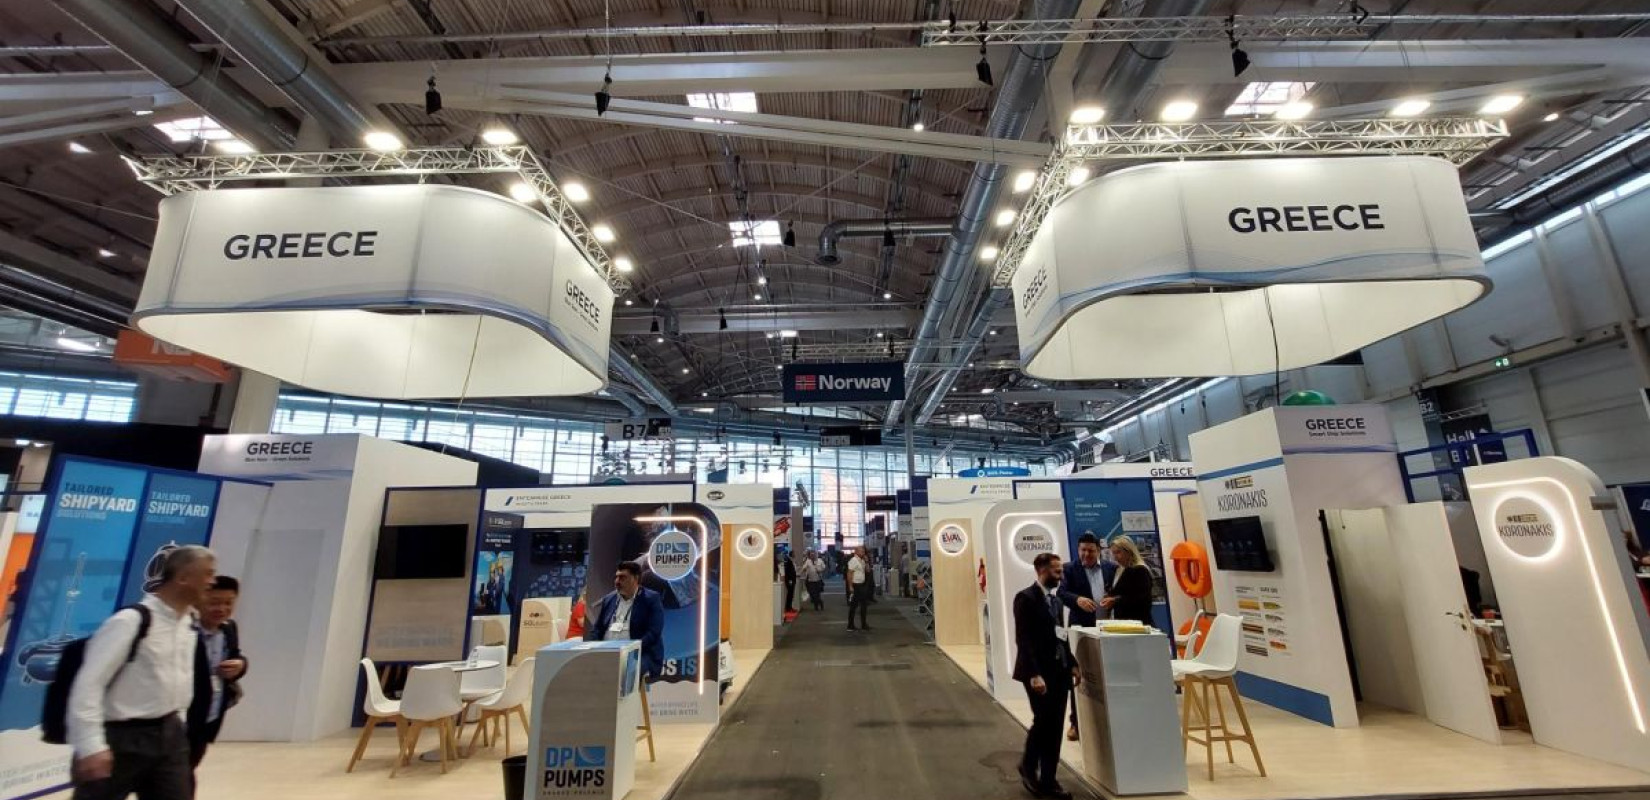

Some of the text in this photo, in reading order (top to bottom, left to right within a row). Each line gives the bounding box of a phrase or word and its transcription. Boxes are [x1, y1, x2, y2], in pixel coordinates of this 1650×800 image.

[1228, 204, 1385, 233] GREECE
[223, 231, 378, 260] GREECE
[1022, 265, 1047, 309] GREECE
[566, 280, 600, 323] GREECE
[819, 374, 891, 392] Norway
[622, 424, 647, 439] B7
[1305, 417, 1366, 430] GREECE
[247, 441, 313, 455] GREECE
[1150, 467, 1194, 477] GREECE
[65, 482, 114, 496] TAILORED
[151, 491, 191, 503] TAILORED
[59, 493, 137, 513] SHIPYARD
[1217, 489, 1268, 511] KORONAKIS
[148, 501, 210, 518] SHIPYARD
[1498, 523, 1554, 537] KORONAKIS
[655, 542, 672, 554] DP
[655, 554, 690, 564] PUMPS
[681, 657, 697, 675] IS
[545, 747, 573, 768] DP
[543, 769, 605, 788] PUMPS
